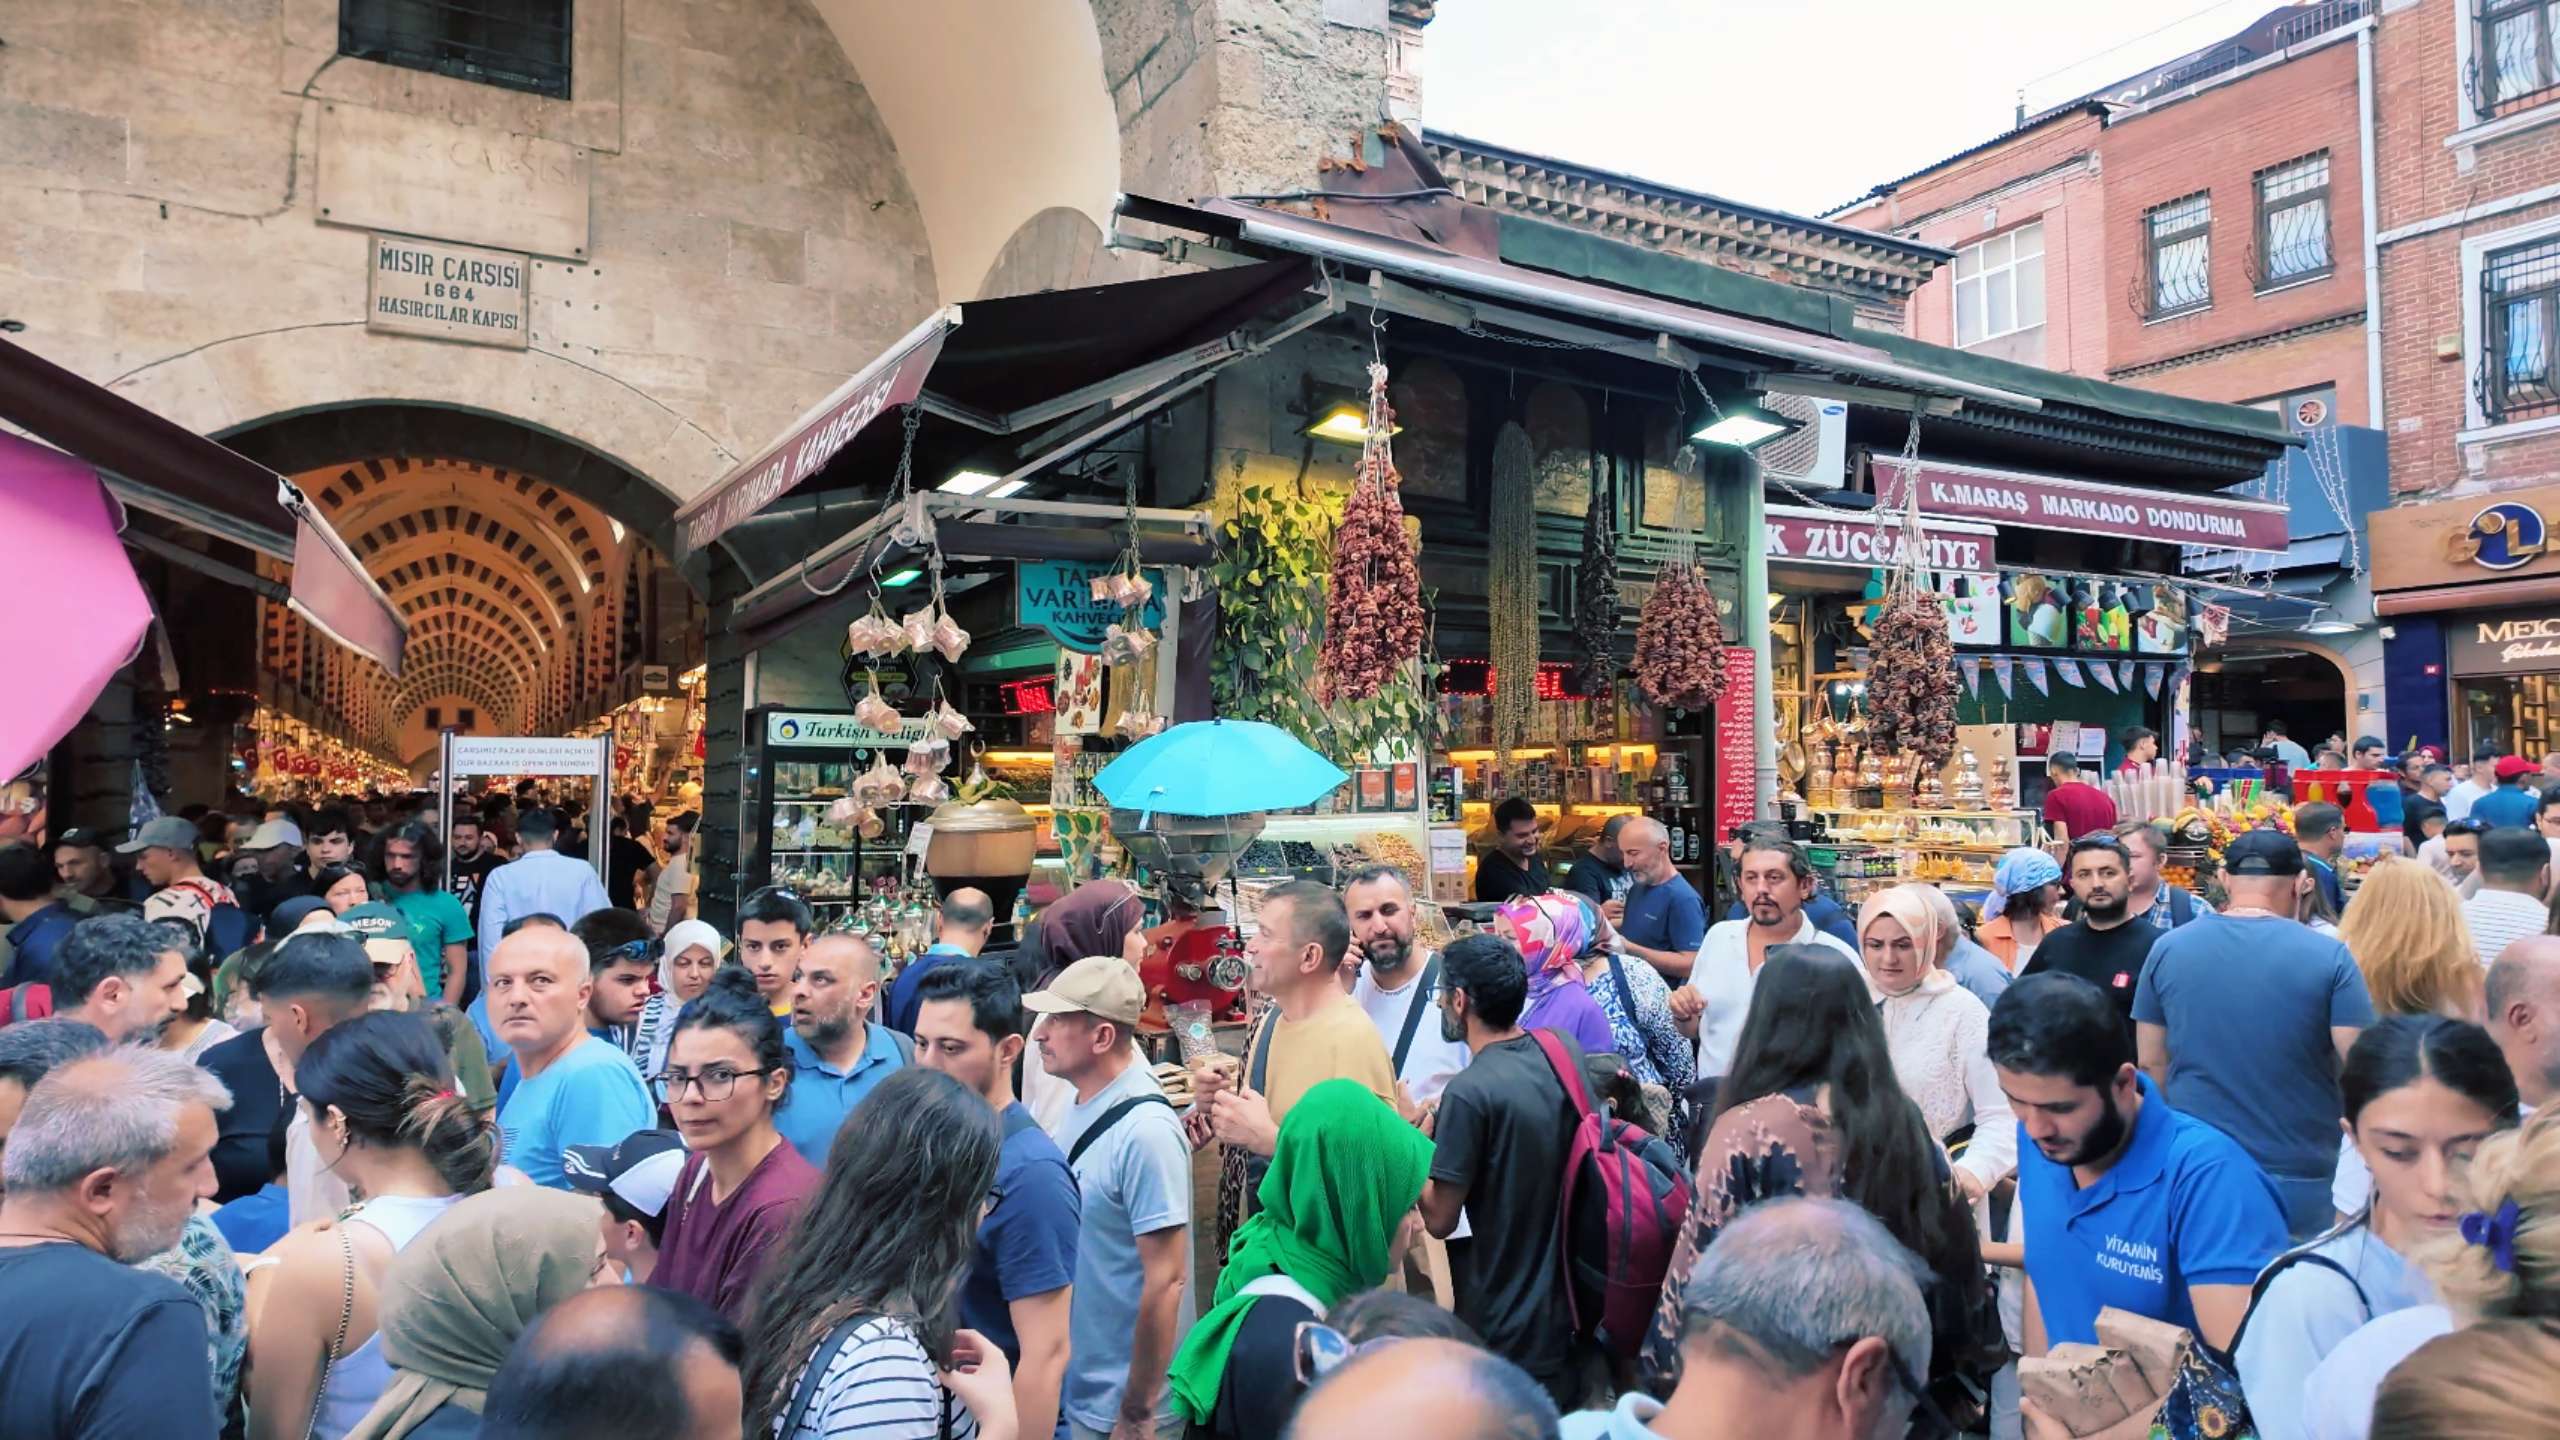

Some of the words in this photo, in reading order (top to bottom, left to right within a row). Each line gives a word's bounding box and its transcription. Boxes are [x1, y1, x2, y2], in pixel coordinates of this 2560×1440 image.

[379, 247, 434, 276] MISIR
[424, 282, 475, 302] 1664
[378, 296, 468, 324] HASIRCILAR
[472, 310, 519, 330] KAPISI
[1930, 481, 2029, 516] K.MARAŞ
[2042, 494, 2140, 525] MARKADO
[2146, 507, 2248, 540] DONDURMA
[2096, 1252, 2164, 1284] KURUYEMİŞ
